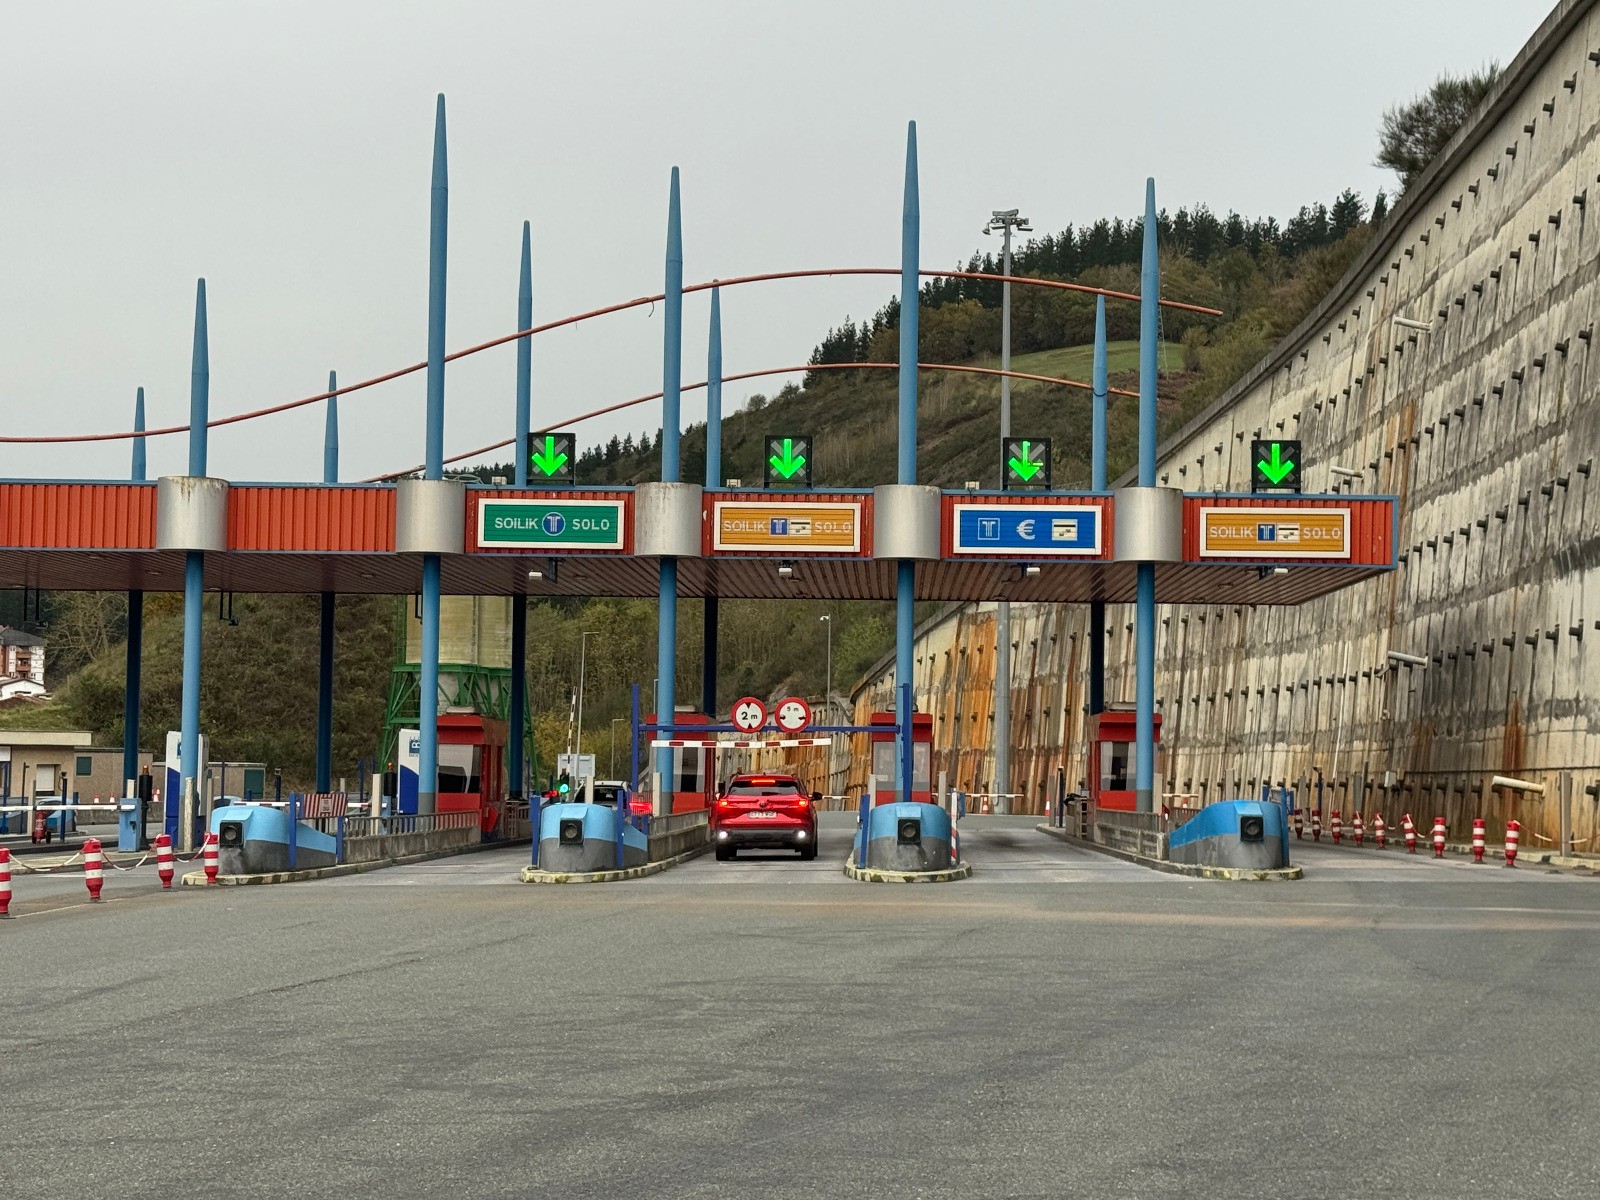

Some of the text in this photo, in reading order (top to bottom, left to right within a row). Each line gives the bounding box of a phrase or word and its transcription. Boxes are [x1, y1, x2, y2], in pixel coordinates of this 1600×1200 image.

[494, 518, 538, 529] SOILIK
[572, 519, 610, 530] SOLO
[722, 520, 767, 532] SOILIK
[814, 521, 852, 533] SOLO
[1209, 526, 1253, 538] SOILIK
[1302, 527, 1341, 539] SOLO
[741, 711, 748, 720] 2
